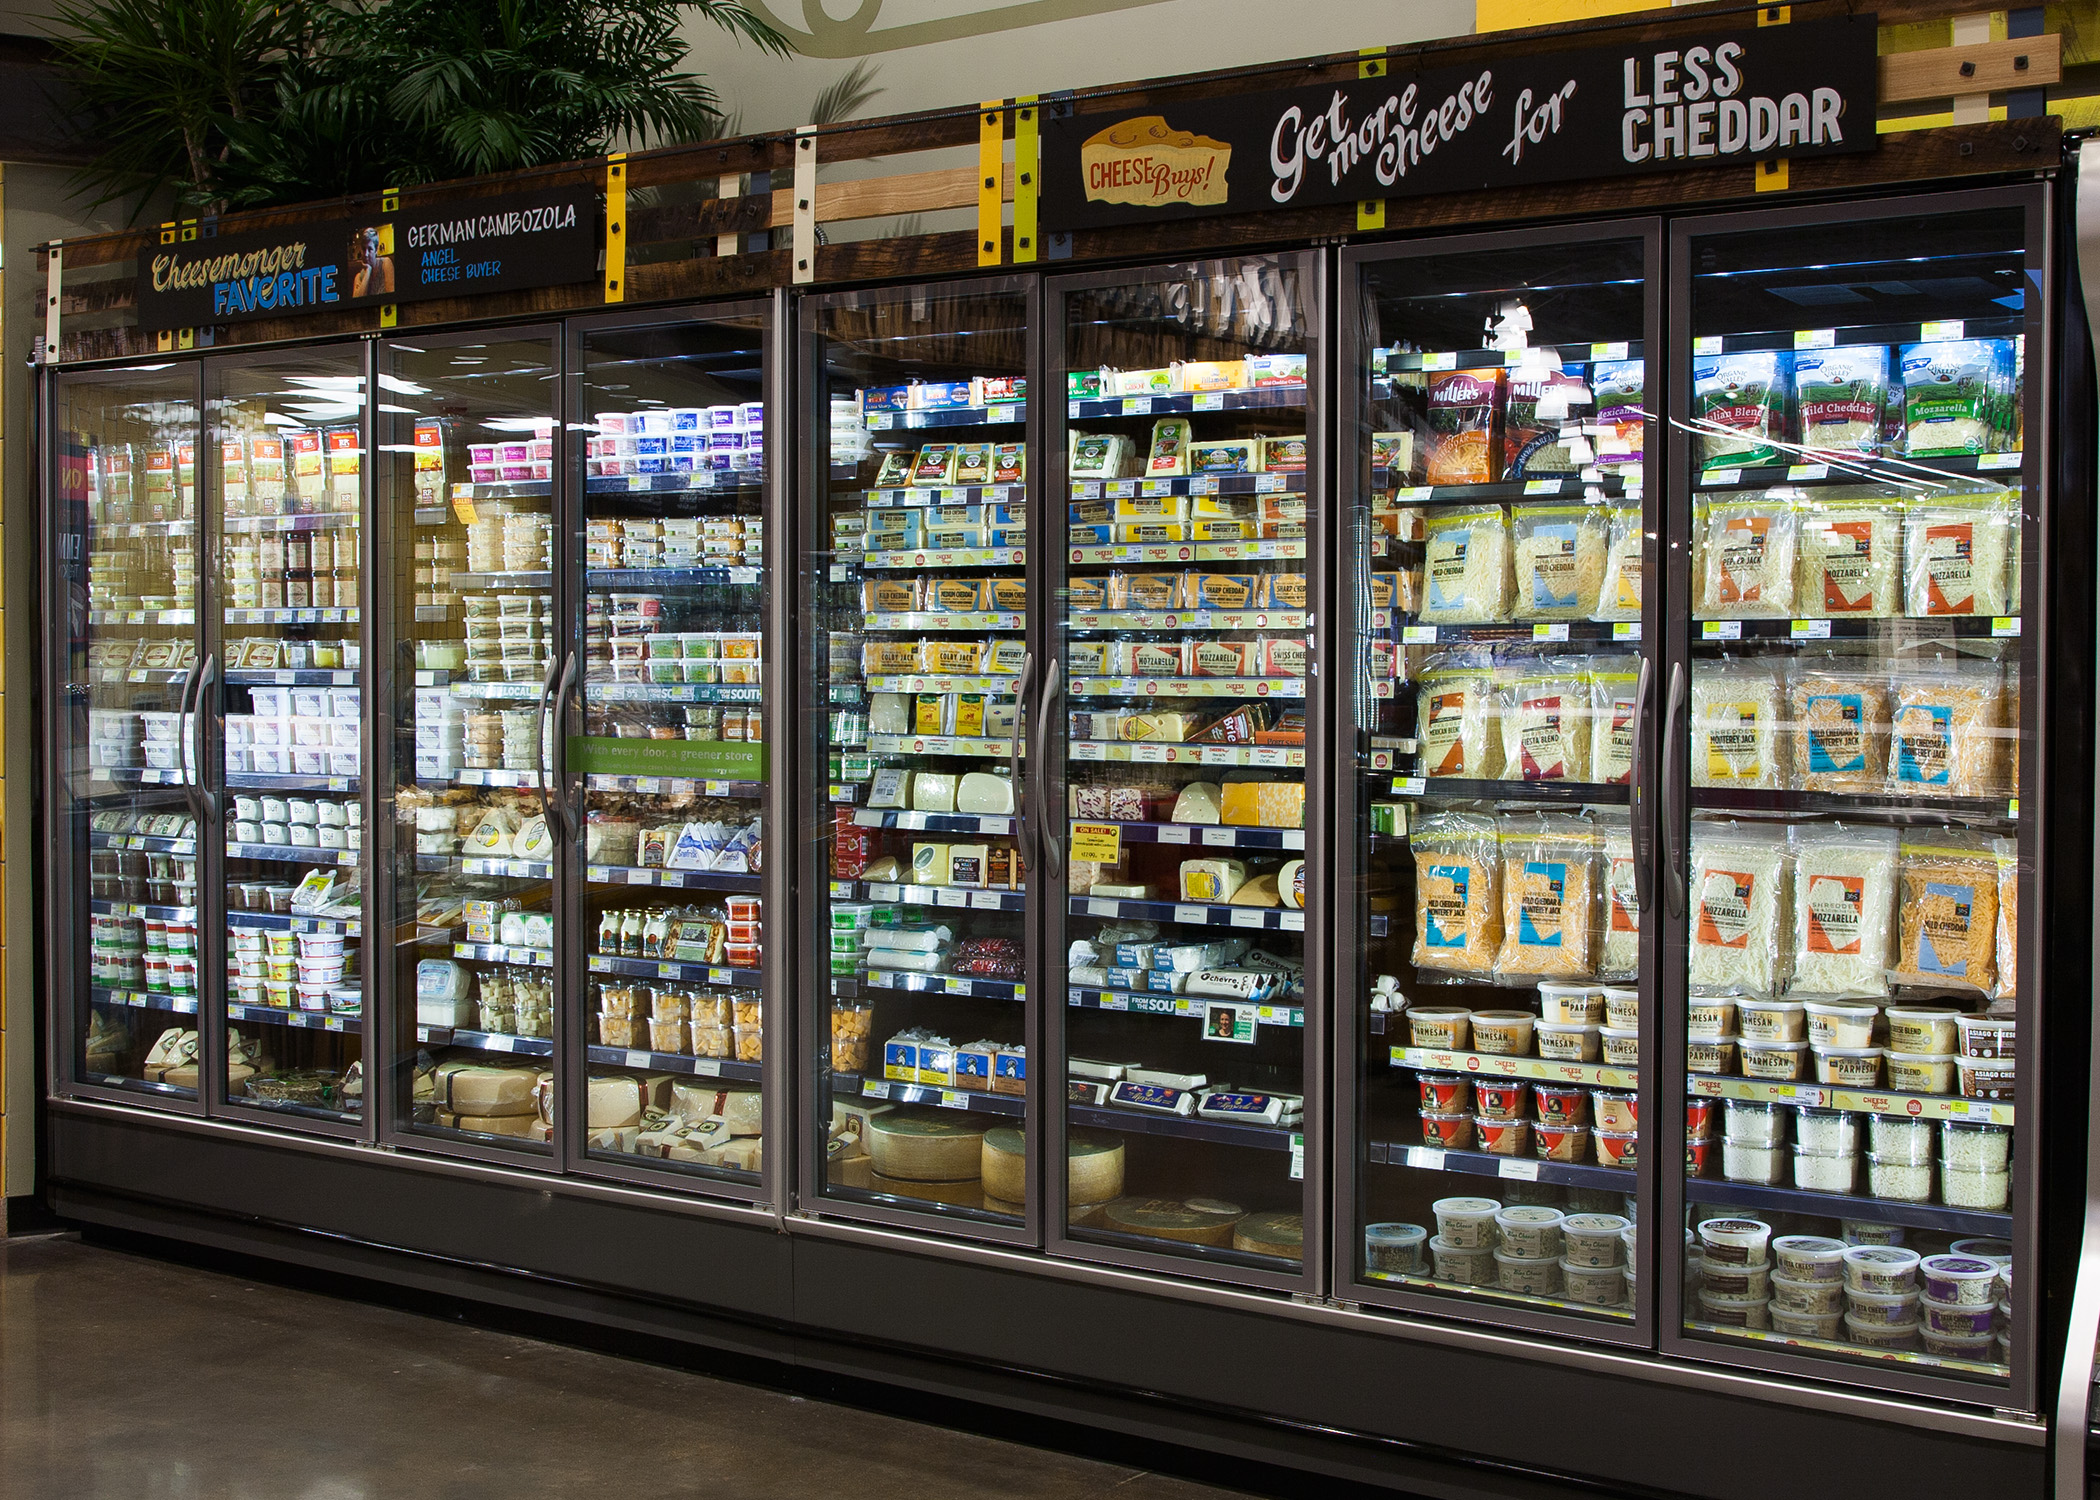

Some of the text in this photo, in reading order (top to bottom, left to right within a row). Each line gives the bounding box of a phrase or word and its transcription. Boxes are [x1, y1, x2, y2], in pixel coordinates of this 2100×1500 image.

[1624, 42, 1745, 109] LESS
[1622, 87, 1846, 164] CHEDDAR
[1271, 69, 1577, 204] Get more cheese for
[1090, 156, 1215, 198] CHEESE Buys!
[408, 204, 576, 248] GERMAN CAMBOZOLA
[421, 249, 459, 267] ANGEL
[151, 242, 306, 298] Cheesemonger
[421, 260, 501, 285] CHEESE BUYER
[214, 265, 339, 315] FAVORITE
[1820, 364, 1854, 373] ORGANIC
[1927, 363, 1961, 373] ORGANIC
[1716, 369, 1749, 379] ORGANIC
[1825, 370, 1850, 379] VALLEY
[1930, 369, 1958, 378] VALLEY
[1722, 374, 1746, 386] VALLEY
[1597, 408, 1629, 418] Mexican
[1826, 403, 1873, 415] Cheddar
[1915, 403, 1968, 415] Mozzarella
[1746, 556, 1761, 565] JACK
[1550, 563, 1575, 571] CHEDDAR
[1826, 569, 1870, 578] MOZZARELLA
[1929, 571, 1971, 580] MOZZARELLA
[1139, 657, 1175, 666] MOZZARELLA
[1200, 654, 1237, 662] MOZZARELLA
[504, 687, 530, 696] LOCAL
[731, 689, 761, 699] SOUTH
[1223, 716, 1237, 742] Brie
[1811, 730, 1853, 738] MILD CHEDDAR
[1522, 735, 1559, 745] FIESTA BLEND
[1710, 735, 1755, 745] MONTEREY JACK
[1811, 737, 1858, 747] MONTEREY JACK
[1901, 738, 1941, 748] MILD CHEDDAR
[583, 743, 608, 755] With
[611, 747, 638, 759] every
[643, 747, 668, 758] door,
[681, 749, 721, 761] greener
[725, 752, 753, 761] store
[1928, 749, 1946, 759] JACK
[1535, 898, 1556, 906] CHEDDAR
[1548, 906, 1561, 914] JACK
[1703, 907, 1747, 918] MOZZARELLA
[1811, 913, 1858, 924] MOZZARELLA
[1923, 920, 1968, 933] MILD CHEDDAR
[1149, 999, 1176, 1012] SOU
[1570, 1003, 1603, 1012] PARMESAN
[1904, 1026, 1922, 1036] BLEND
[1969, 1029, 1989, 1038] ASIAGO
[1476, 1033, 1509, 1041] PARMESAN
[1540, 1038, 1574, 1047] PARMESAN
[1431, 1054, 1452, 1062] CHEESE
[1749, 1057, 1789, 1067] PARMESAN
[1839, 1064, 1879, 1074] PARMESAN
[1904, 1068, 1921, 1077] BLEND
[1697, 1081, 1721, 1089] CHEESE
[1863, 1097, 1888, 1106] CHEESE
[1457, 1222, 1472, 1230] Cheese
[1580, 1240, 1592, 1248] Blue
[1451, 1258, 1465, 1266] Cheese
[1784, 1262, 1815, 1272] FETA CHEESE
[1873, 1274, 1906, 1282] FETA CHEESE
[1855, 1304, 1888, 1315] FETA CHEESE
[1870, 1337, 1891, 1347] CHEESE
